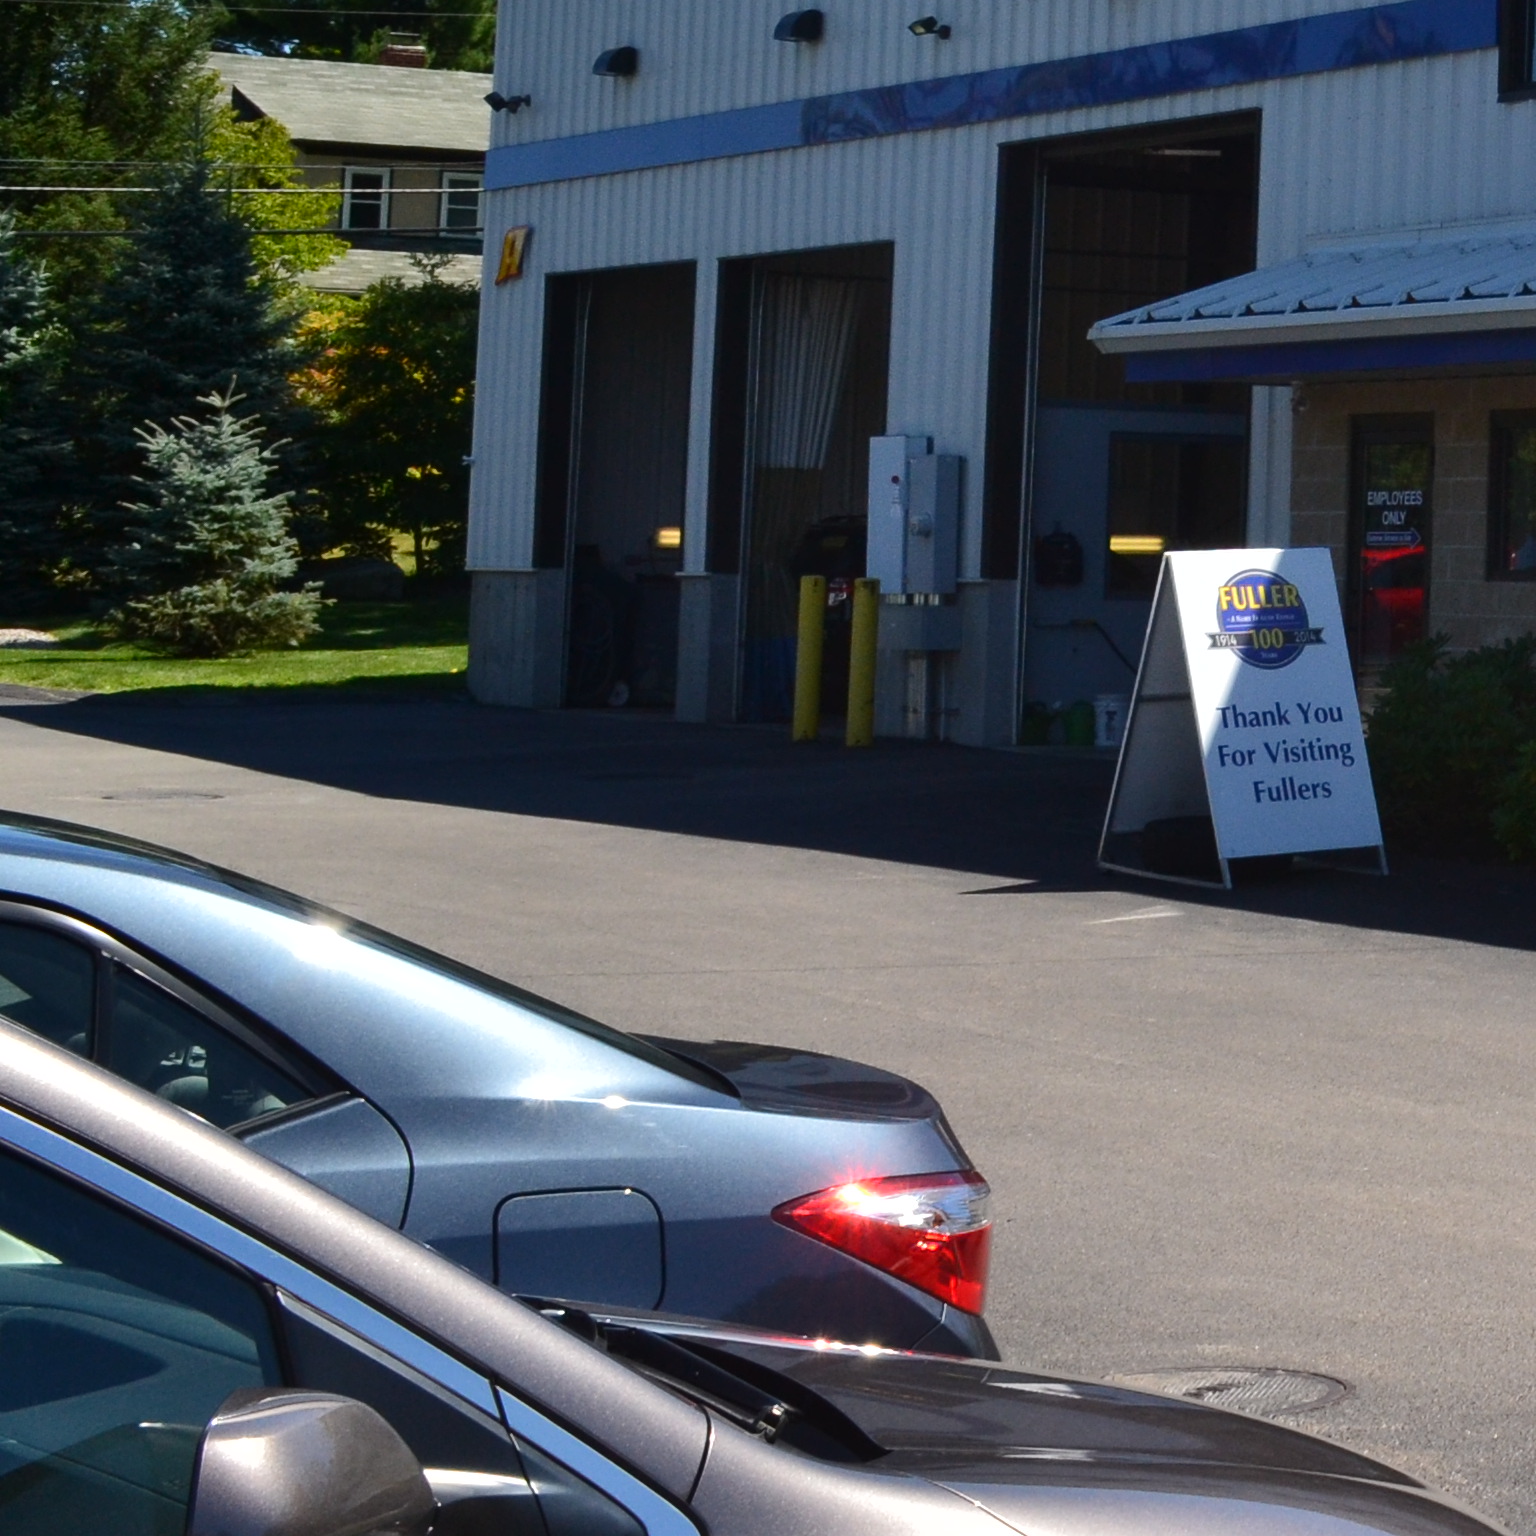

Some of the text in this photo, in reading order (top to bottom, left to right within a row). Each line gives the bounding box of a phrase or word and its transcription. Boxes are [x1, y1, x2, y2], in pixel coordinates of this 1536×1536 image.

[1367, 490, 1423, 506] EMPLOYEES
[1382, 510, 1407, 525] ONLY
[1219, 585, 1300, 611] FULLER
[1215, 628, 1318, 650] 1914 100 2014
[1216, 702, 1344, 729] Thank You
[1217, 737, 1355, 768] For Visiting
[1253, 776, 1333, 803] Fullers
